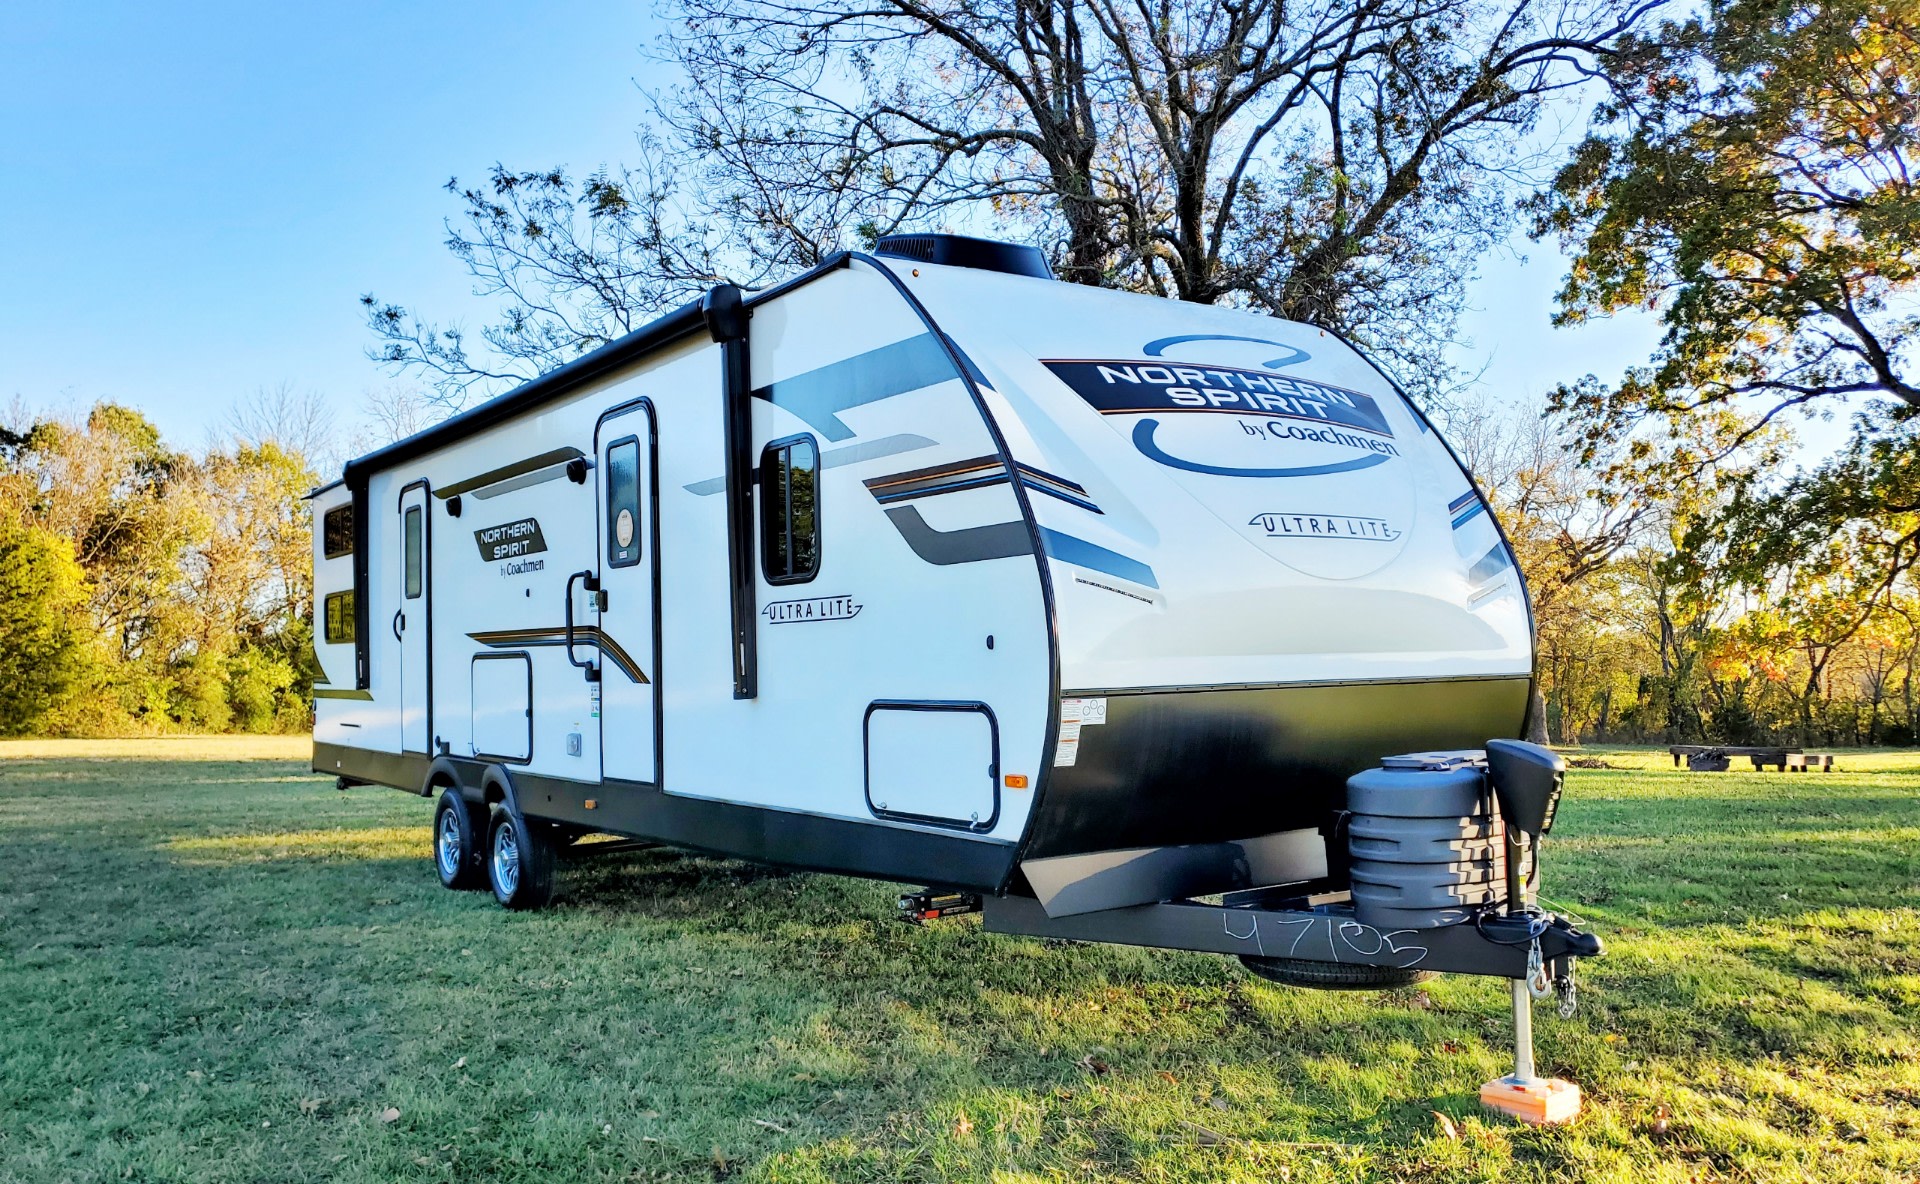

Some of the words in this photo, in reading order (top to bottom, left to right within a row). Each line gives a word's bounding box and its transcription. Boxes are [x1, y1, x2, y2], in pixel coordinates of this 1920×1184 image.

[1096, 365, 1357, 409] NORTHERN
[1165, 387, 1329, 418] SPIRIT
[1238, 420, 1266, 440] by
[1266, 421, 1400, 457] Coachmen
[480, 520, 535, 544] NORTHERN
[1262, 516, 1338, 534] ULTRA
[1347, 519, 1391, 537] LITE
[493, 540, 530, 559] SPIRIT
[506, 559, 544, 576] Coachmen
[769, 603, 813, 620] ULTRA
[820, 599, 853, 616] LITE
